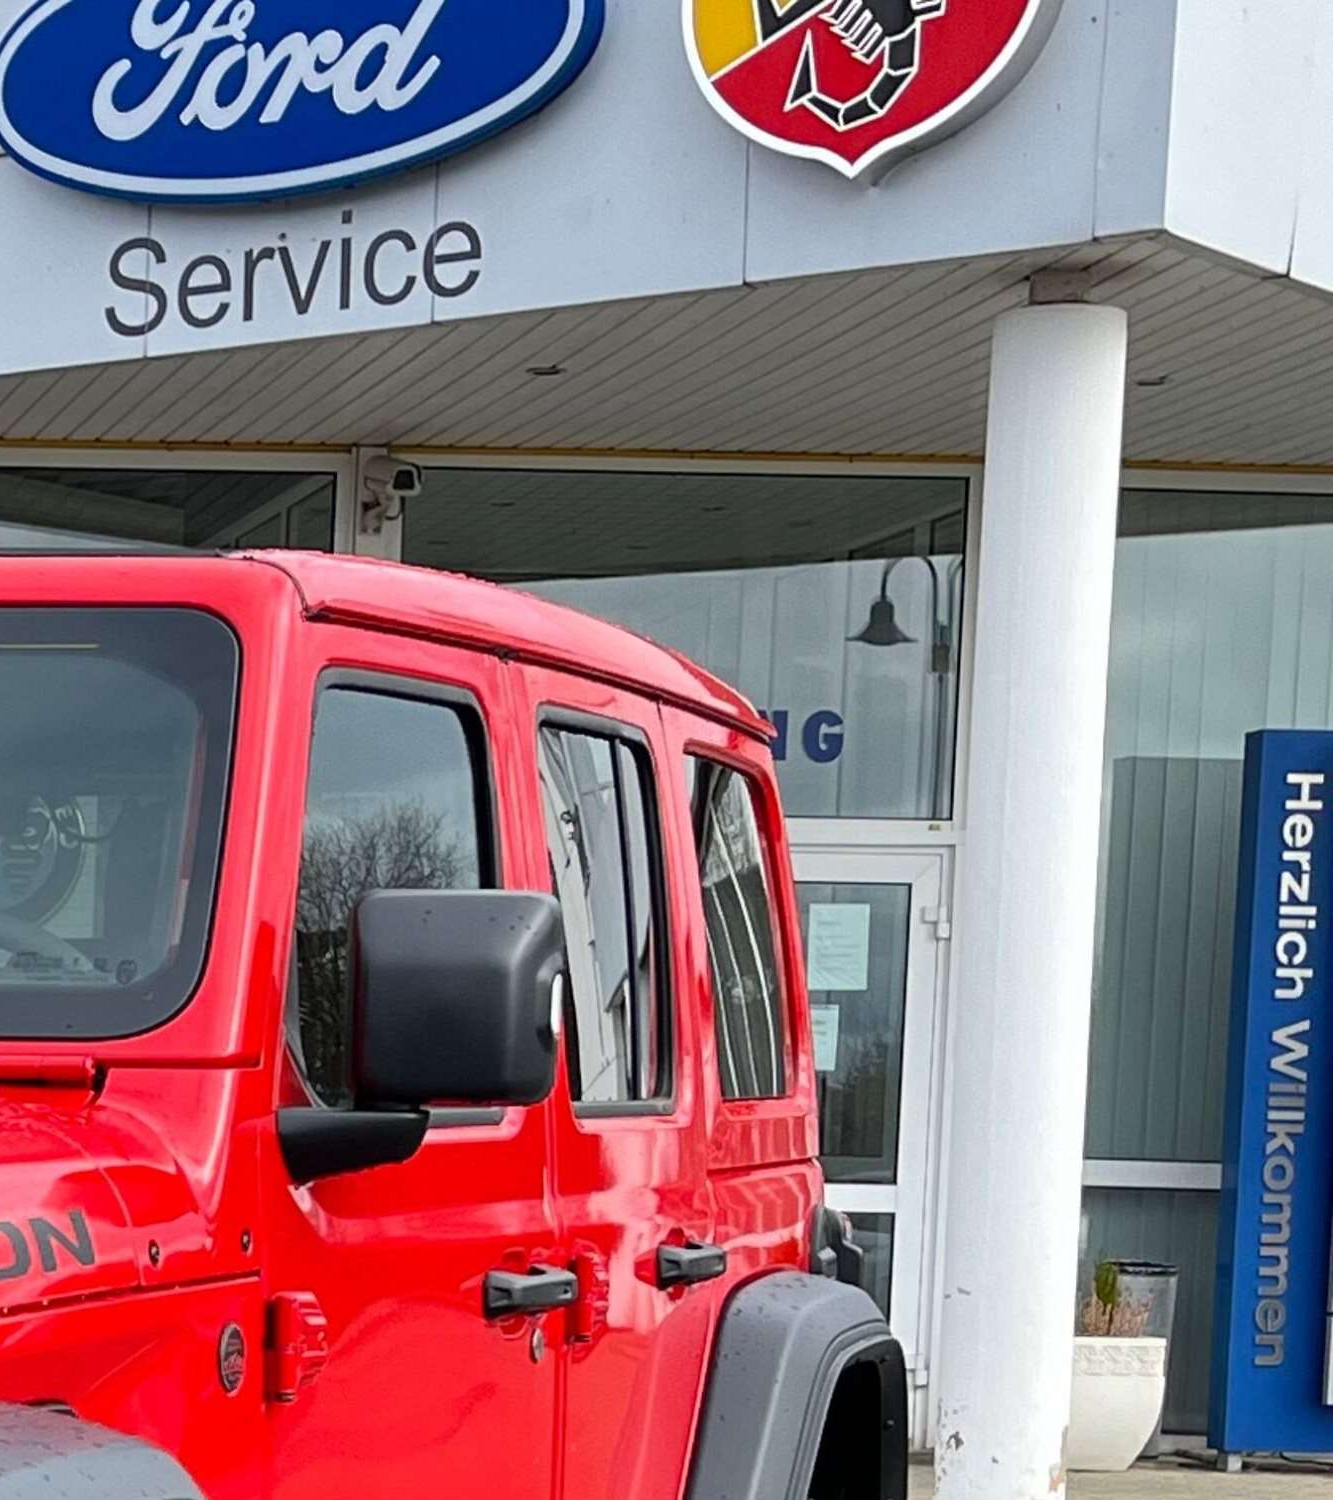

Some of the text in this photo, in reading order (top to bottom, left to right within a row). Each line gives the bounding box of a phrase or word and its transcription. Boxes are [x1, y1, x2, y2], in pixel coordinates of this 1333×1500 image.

[93, 0, 441, 141] Ford
[105, 210, 482, 337] Service
[1252, 770, 1325, 1369] Herzlich Willkommen
